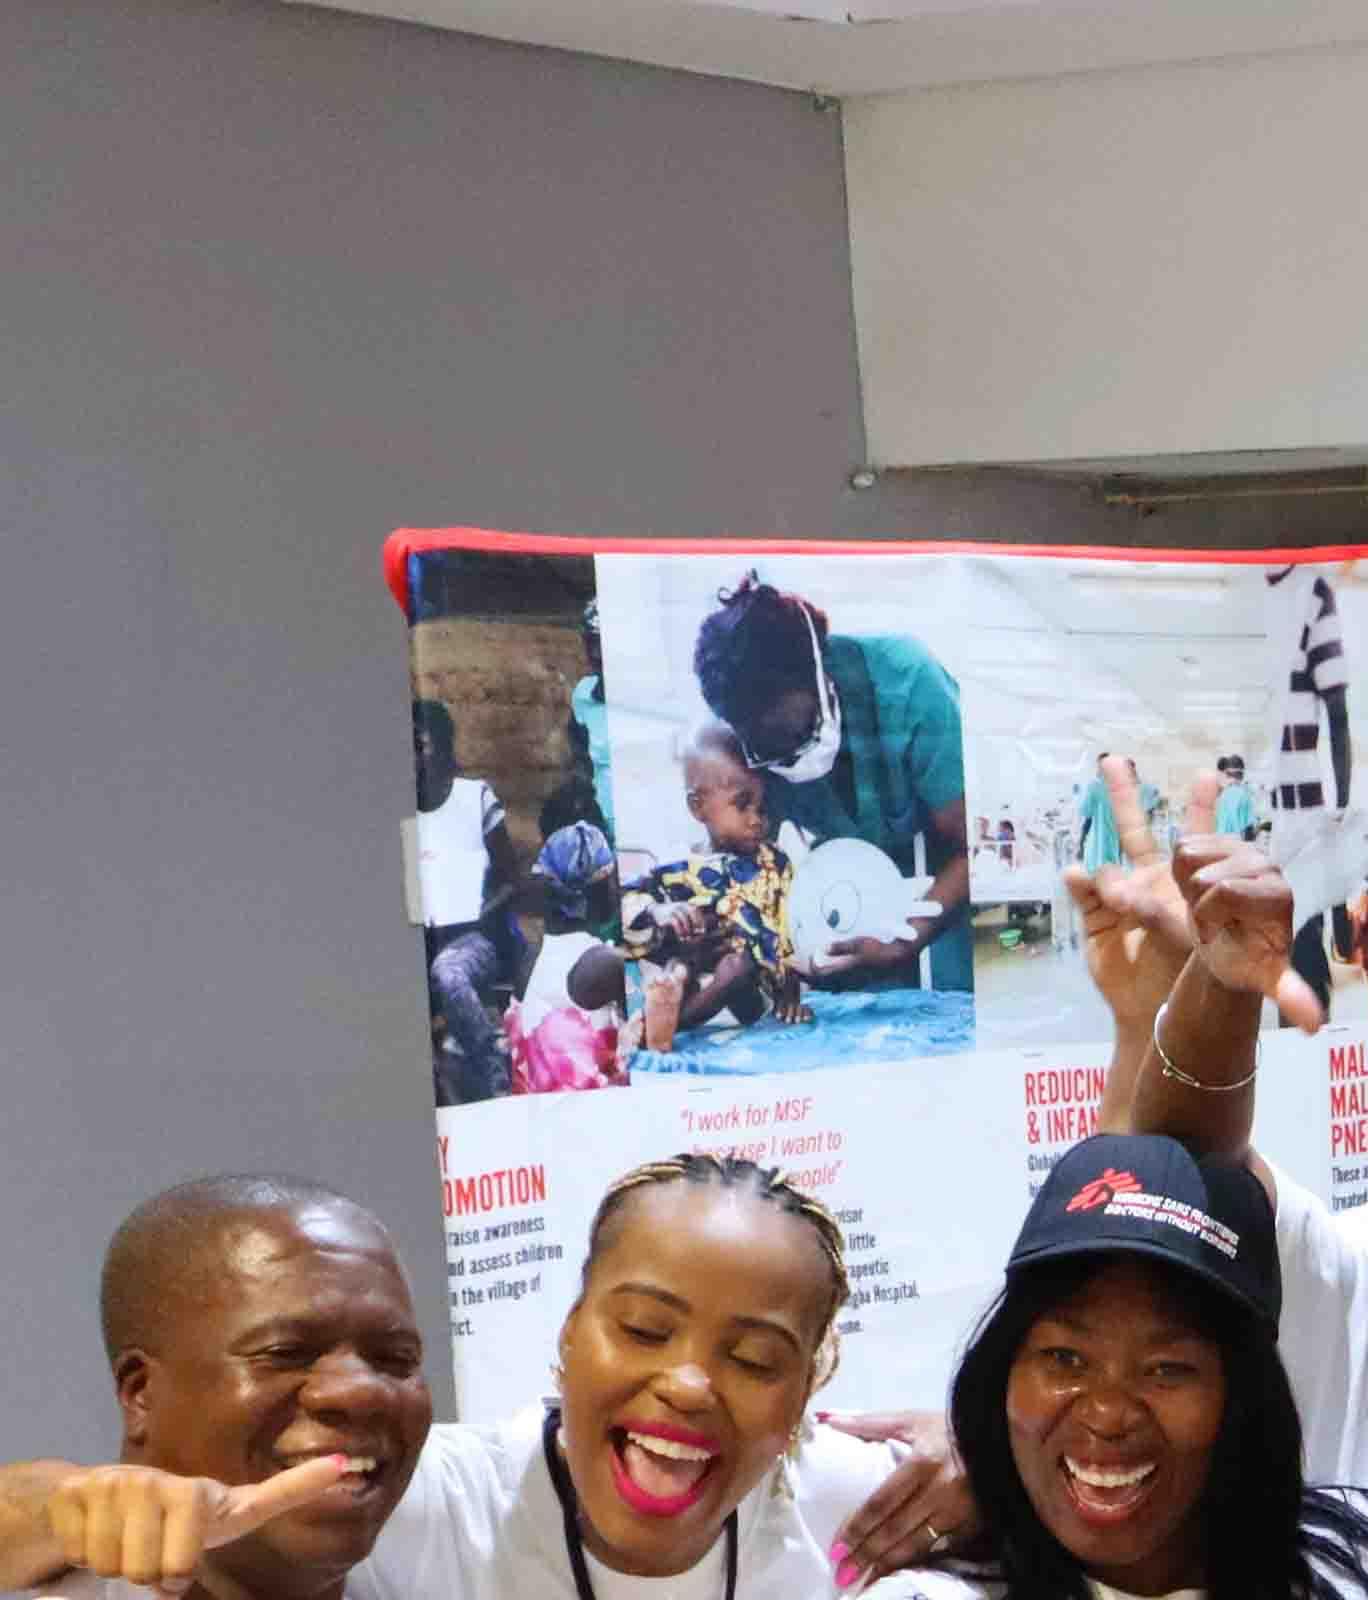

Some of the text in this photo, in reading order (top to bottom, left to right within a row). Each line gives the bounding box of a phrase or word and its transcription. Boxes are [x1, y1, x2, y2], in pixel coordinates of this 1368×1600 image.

[1025, 1067, 1105, 1106] REDUCIN
[698, 1108, 741, 1132] work
[744, 1103, 770, 1132] for
[773, 1097, 815, 1124] MSF
[1027, 1106, 1099, 1145] & INFAN
[781, 1131, 823, 1157] want
[827, 1130, 843, 1152] to
[1332, 1165, 1361, 1184] These
[484, 1216, 545, 1242] awareness
[848, 1231, 877, 1251] little
[469, 1252, 513, 1276] assess
[514, 1243, 564, 1267] children
[462, 1288, 484, 1306] the
[486, 1278, 528, 1301] village
